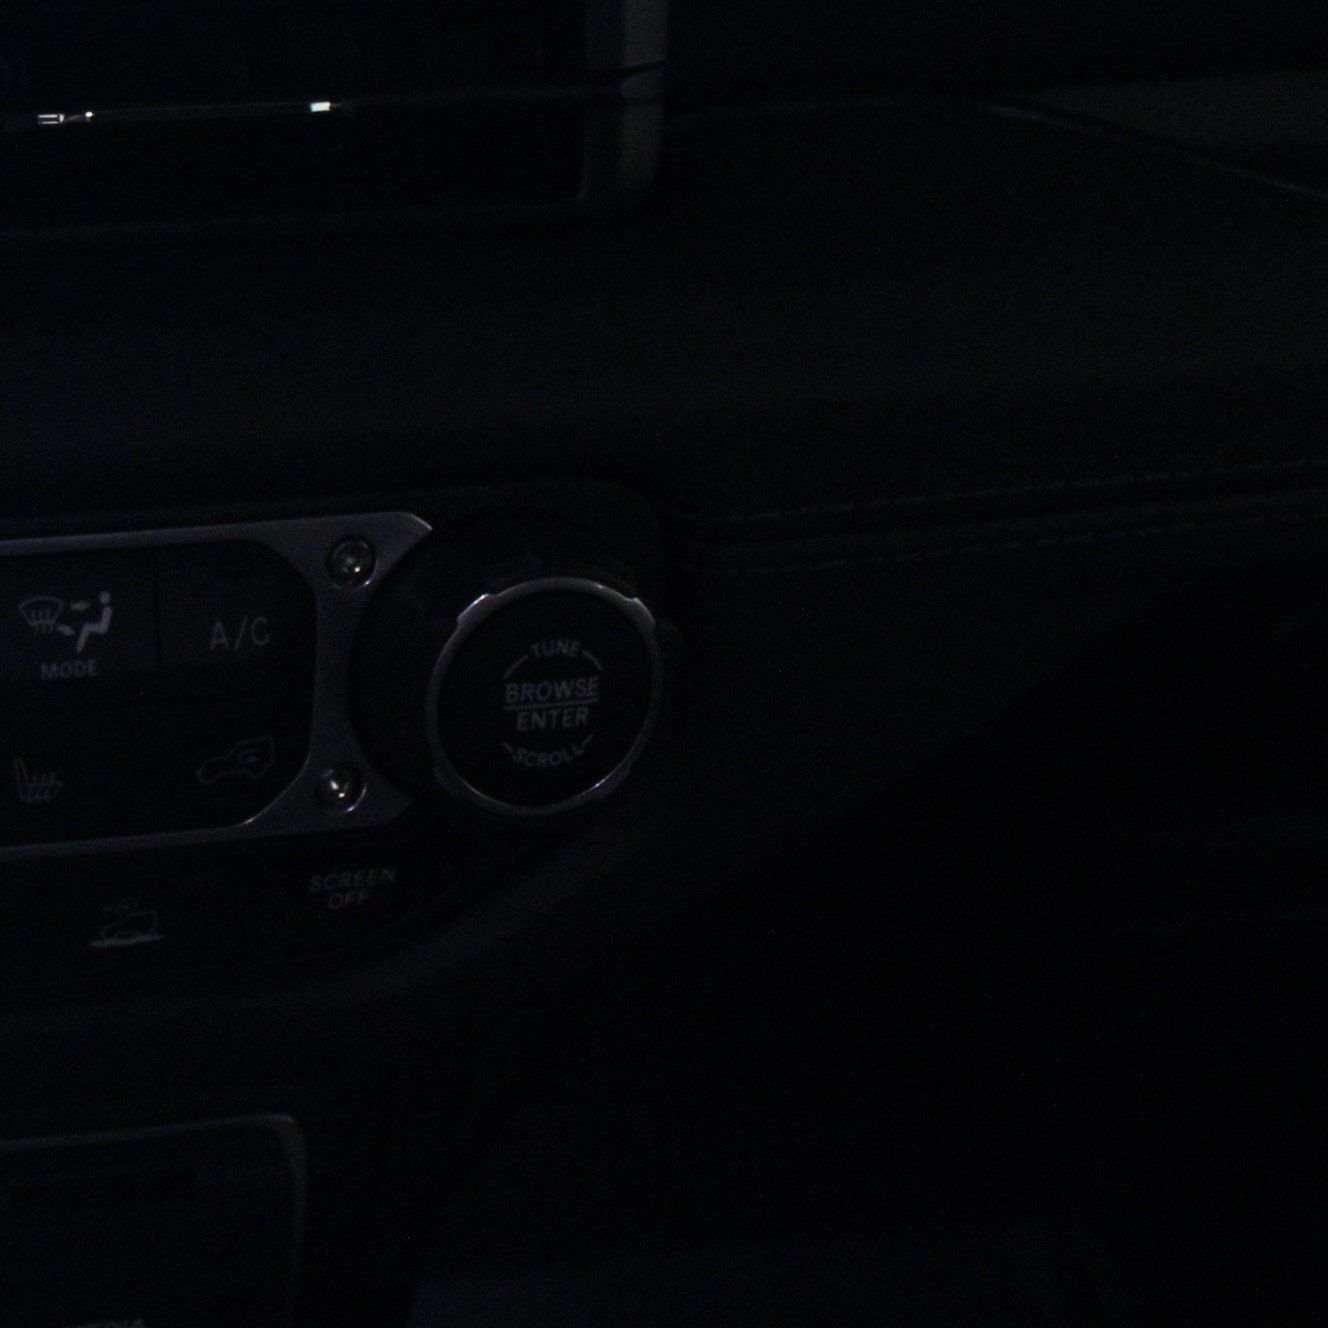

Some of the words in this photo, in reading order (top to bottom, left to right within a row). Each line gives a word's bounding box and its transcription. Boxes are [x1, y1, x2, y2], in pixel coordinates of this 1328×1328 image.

[209, 616, 271, 651] A/C
[530, 639, 584, 659] TUNE
[41, 658, 98, 681] MODE
[504, 676, 601, 706] BROWSE
[514, 706, 591, 732] ENTER
[512, 744, 588, 769] SCROLL
[309, 868, 397, 893] SCREEN
